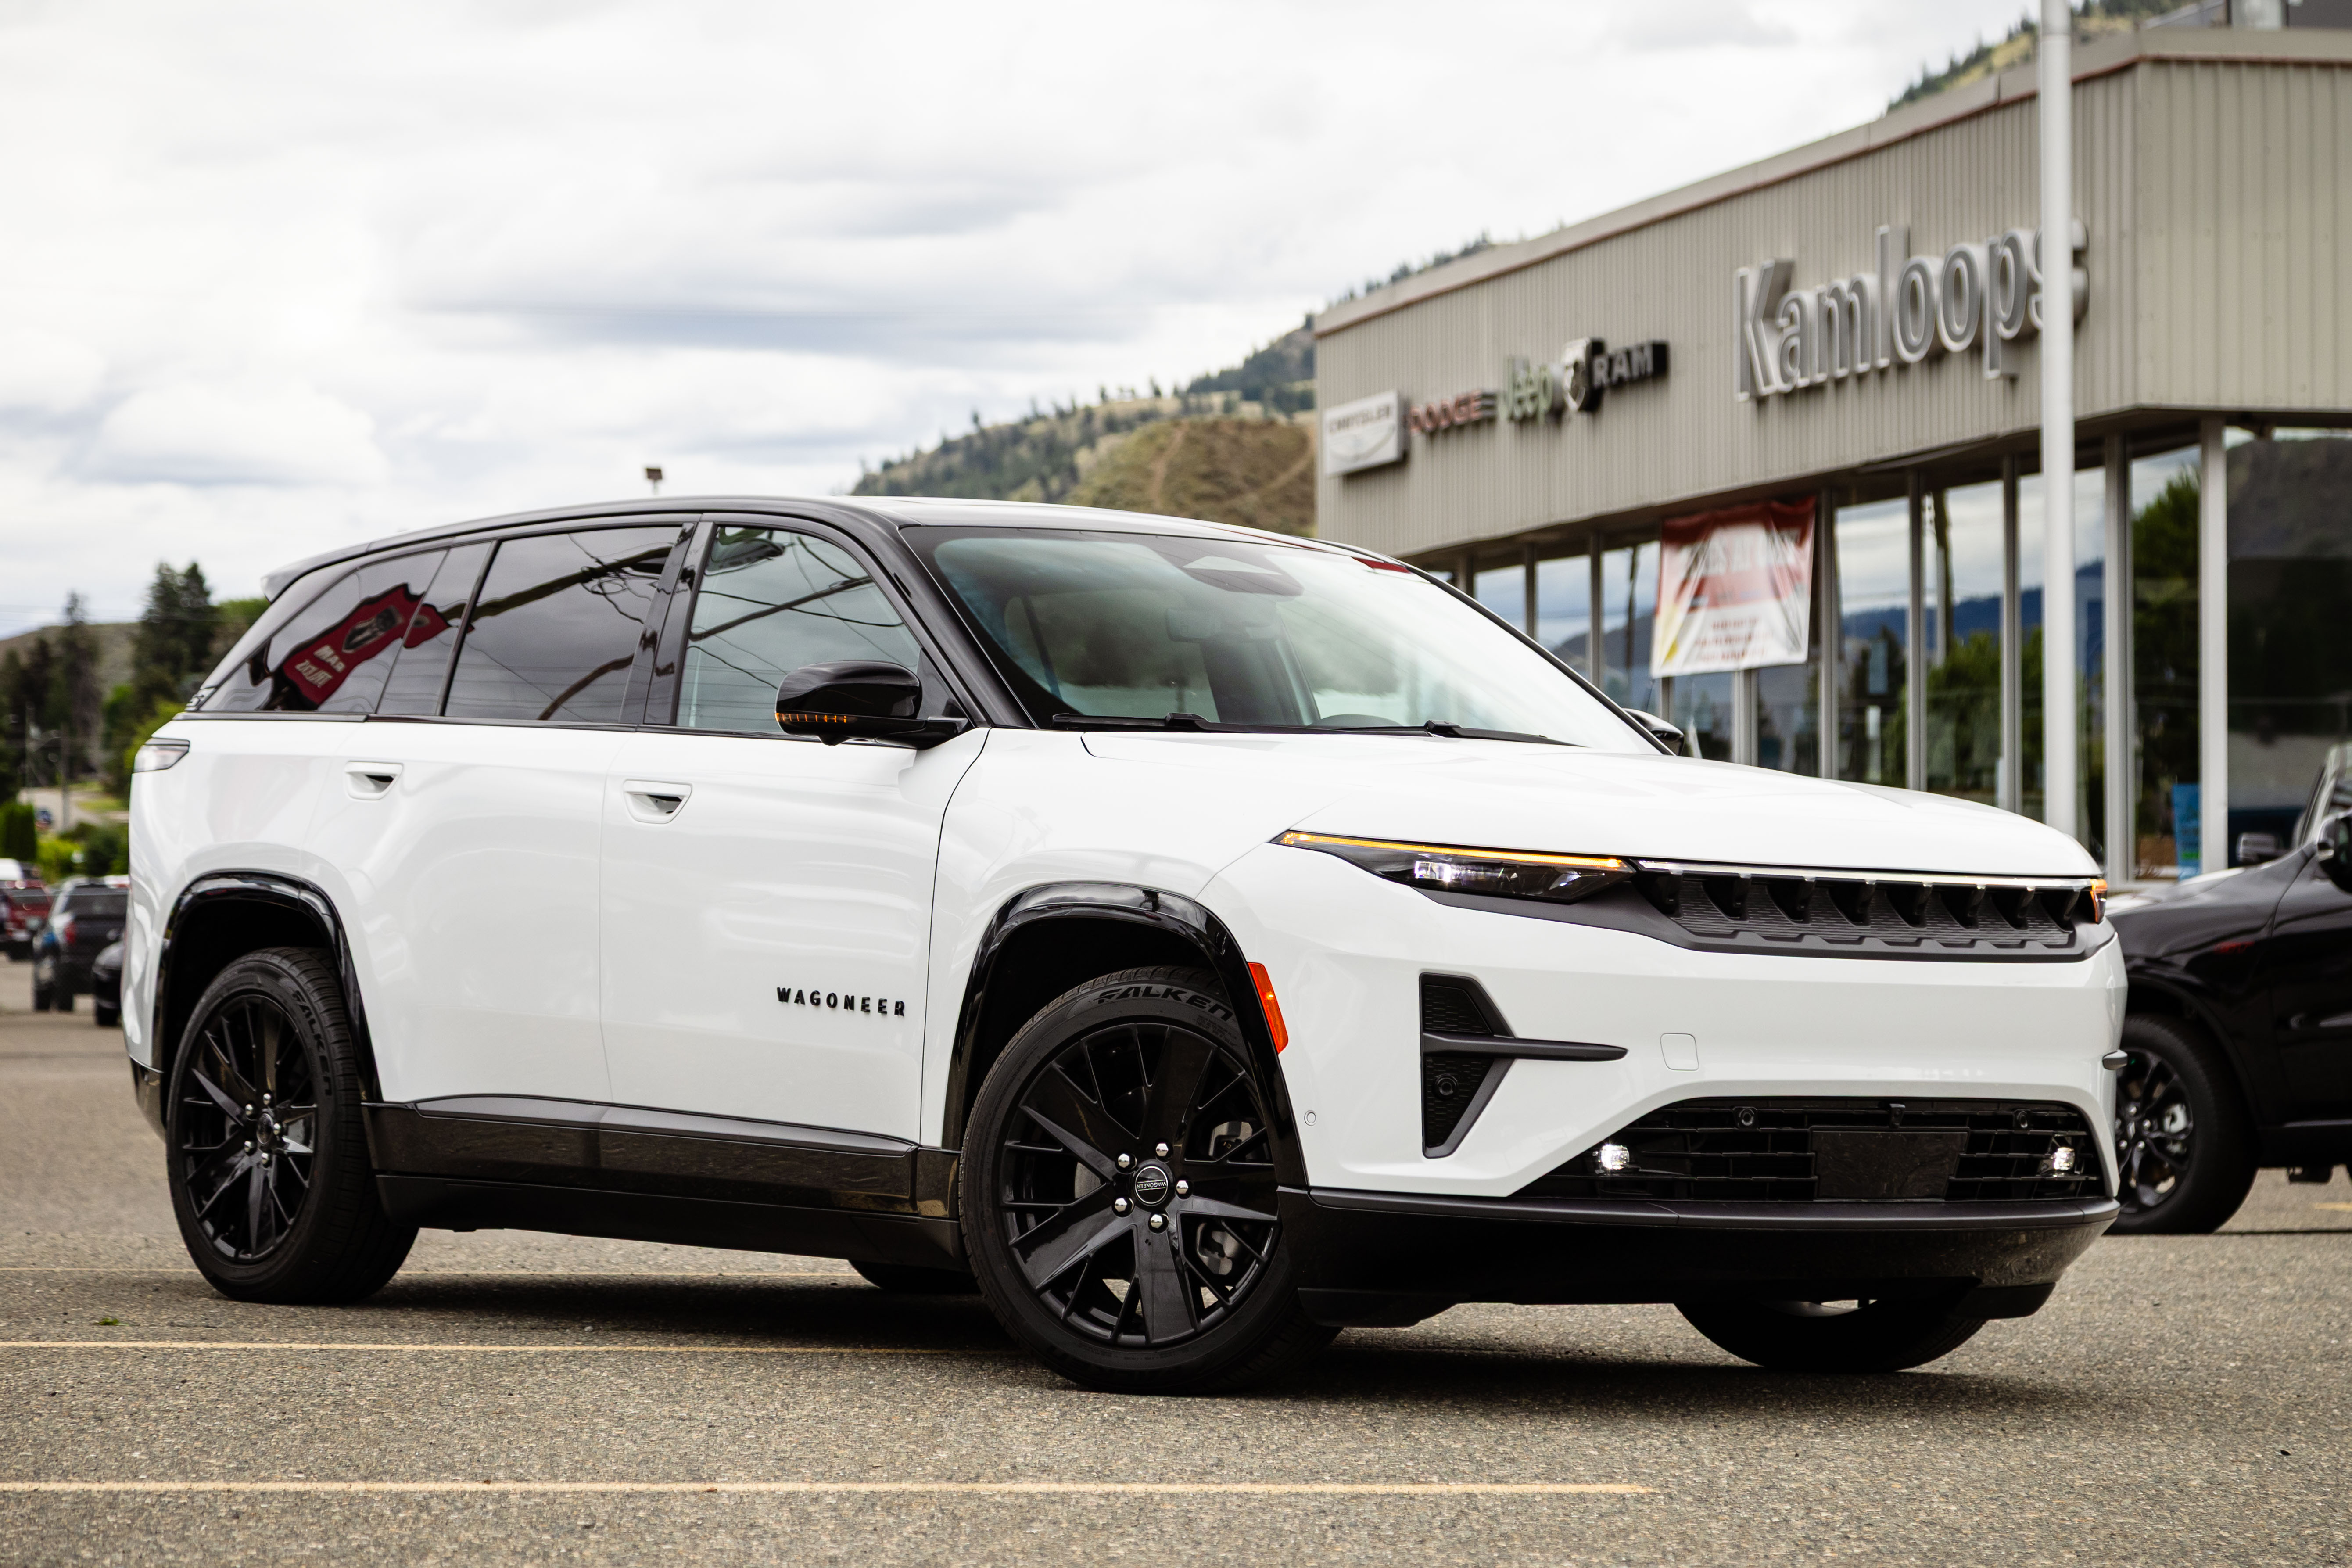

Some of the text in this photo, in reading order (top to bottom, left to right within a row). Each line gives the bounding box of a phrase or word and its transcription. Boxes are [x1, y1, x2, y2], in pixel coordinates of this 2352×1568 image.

[1592, 343, 1654, 389] RAM
[1409, 389, 1483, 434] DODGE
[1499, 355, 1554, 425] Jeep
[776, 987, 905, 1017] WAGONEER
[1094, 986, 1233, 1022] FALKEN
